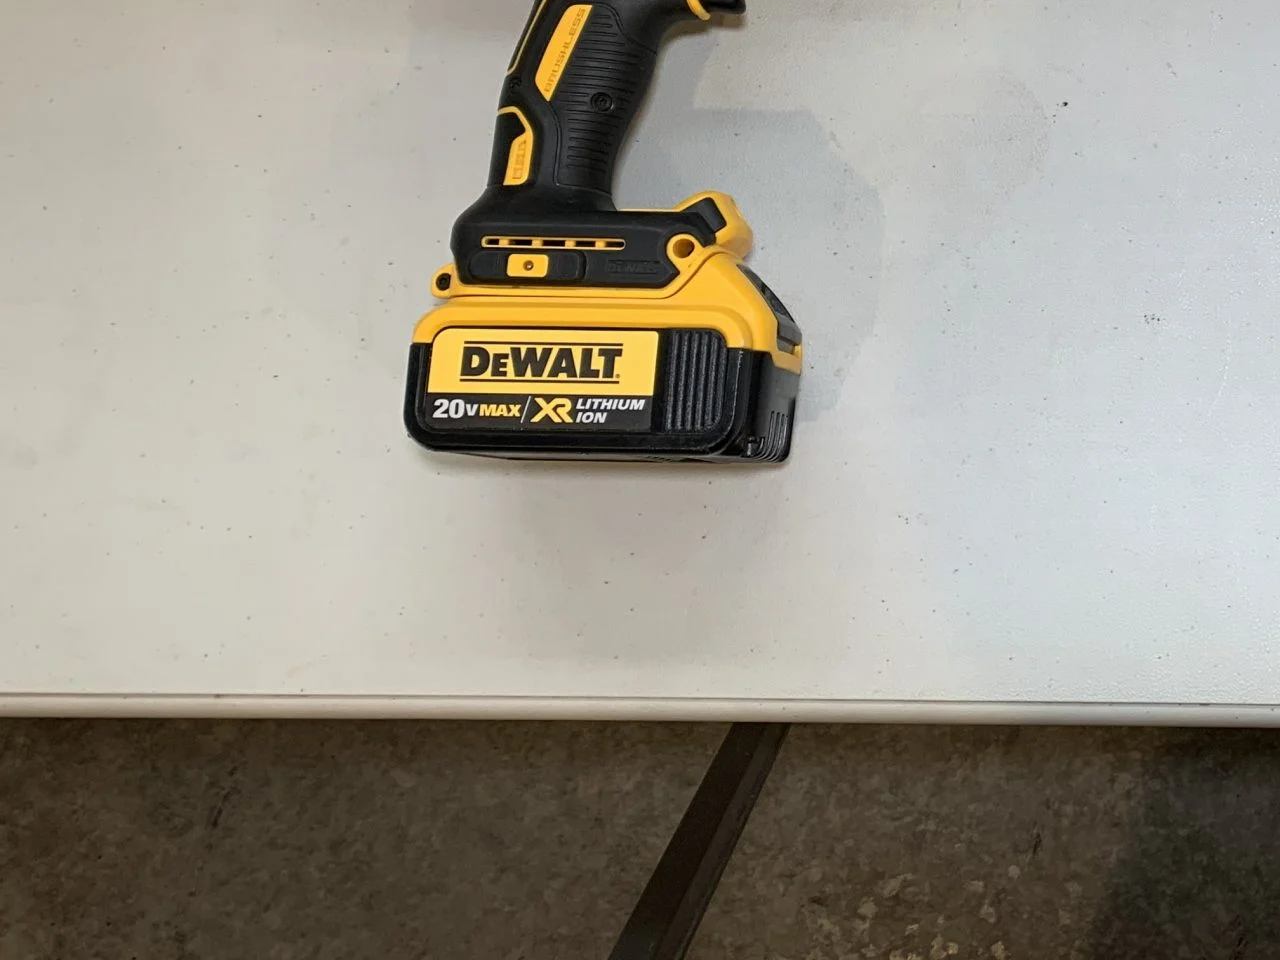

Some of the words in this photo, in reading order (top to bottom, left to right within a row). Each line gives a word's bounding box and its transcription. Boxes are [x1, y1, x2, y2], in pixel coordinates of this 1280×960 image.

[544, 8, 586, 92] BRUSHLESS
[460, 346, 622, 379] DEWALT
[530, 397, 574, 423] XR
[576, 398, 646, 410] LITHIUM
[576, 412, 608, 424] ION
